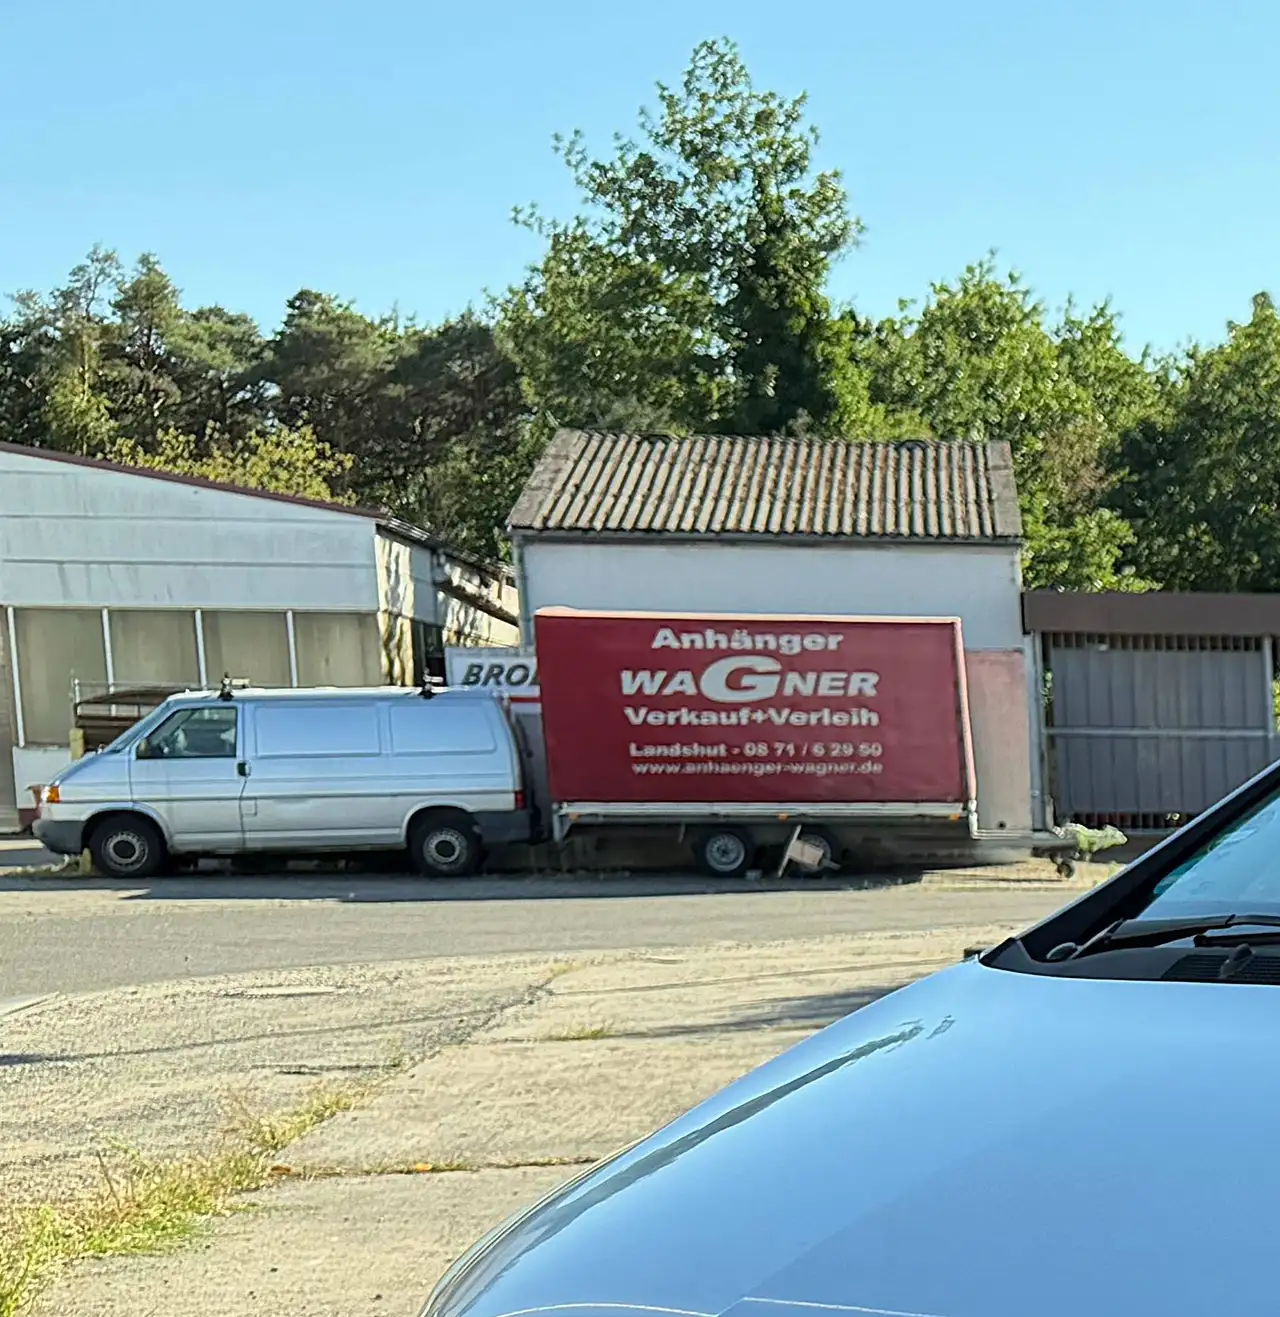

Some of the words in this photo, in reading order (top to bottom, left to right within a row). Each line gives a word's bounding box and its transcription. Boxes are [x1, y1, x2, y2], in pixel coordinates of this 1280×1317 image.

[651, 628, 844, 655] Anhänger
[620, 655, 880, 703] WAGNER
[623, 706, 880, 726] Verkauf+Verleih
[629, 742, 727, 758] Landshut
[744, 743, 768, 758] 08
[813, 743, 824, 757] 6
[829, 743, 853, 757] 29
[632, 760, 883, 776] www.anhaenger-wagner.de
